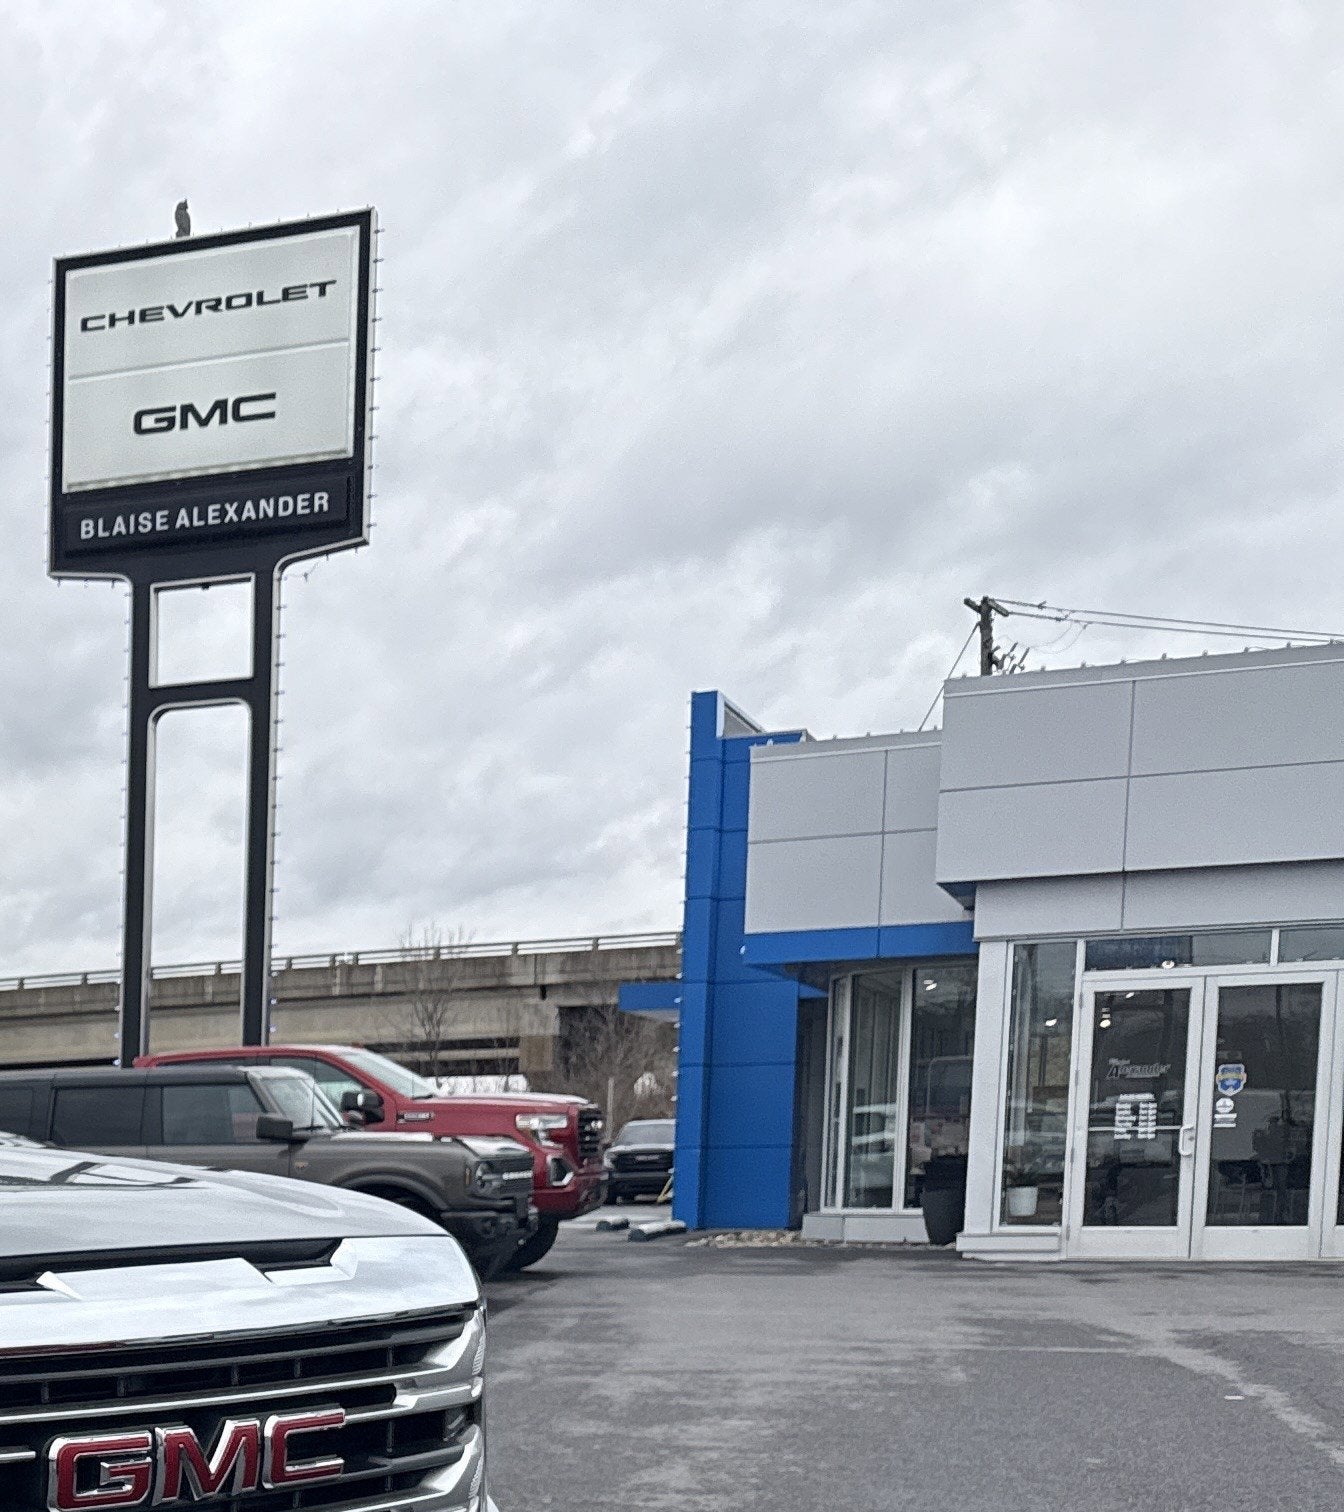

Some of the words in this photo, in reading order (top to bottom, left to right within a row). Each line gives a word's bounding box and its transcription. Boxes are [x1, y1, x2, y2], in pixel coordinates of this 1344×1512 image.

[80, 279, 337, 333] CHEVROLET
[132, 391, 277, 435] GMC
[80, 509, 169, 540] BLAISE
[175, 491, 330, 529] ALEXANDER
